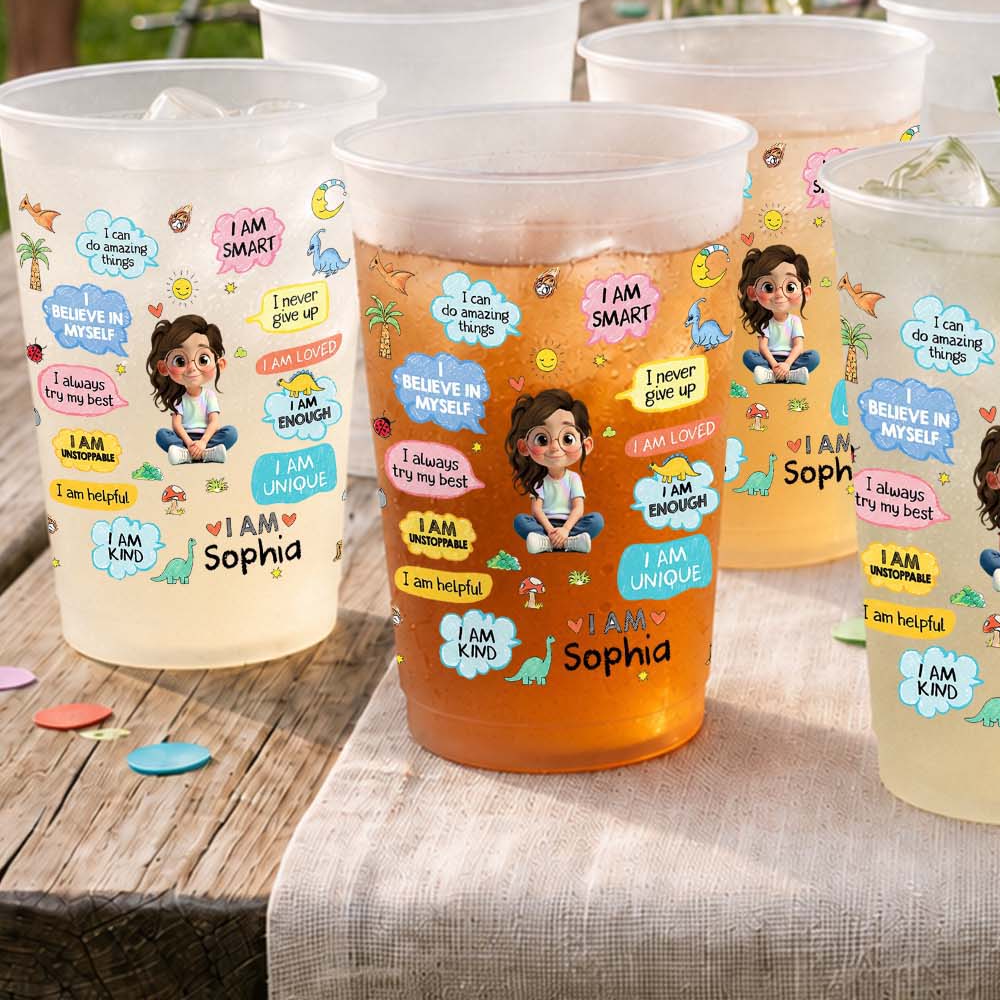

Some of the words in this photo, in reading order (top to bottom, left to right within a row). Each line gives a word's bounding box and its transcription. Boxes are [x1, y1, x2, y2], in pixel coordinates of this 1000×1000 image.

[103, 227, 110, 239] I
[111, 231, 131, 241] can
[231, 221, 236, 236] I
[240, 216, 267, 237] AM
[85, 239, 101, 251] do
[103, 243, 148, 257] amazing
[222, 235, 276, 258] SMART
[101, 254, 135, 270] things
[84, 292, 89, 306] I
[272, 294, 279, 310] I
[282, 290, 319, 308] never
[462, 291, 467, 303] I
[470, 295, 491, 305] can
[602, 287, 607, 304] I
[612, 283, 641, 304] AM
[51, 304, 106, 324] BELIEVE
[108, 311, 124, 326] IN
[272, 309, 299, 329] give
[302, 306, 319, 321] up
[441, 303, 458, 317] do
[460, 308, 510, 325] amazing
[592, 304, 652, 328] SMART
[934, 315, 940, 329] I
[942, 321, 964, 332] can
[64, 323, 115, 341] MYSELF
[458, 320, 495, 338] things
[911, 328, 929, 342] do
[931, 334, 983, 352] amazing
[263, 359, 266, 371] I
[271, 354, 293, 370] AM
[296, 340, 337, 363] LOVED
[928, 346, 967, 366] things
[438, 361, 443, 377] I
[53, 371, 59, 385] I
[62, 375, 106, 392] always
[402, 373, 461, 397] BELIEVE
[464, 384, 481, 399] IN
[44, 385, 64, 403] try
[66, 393, 84, 406] my
[87, 393, 114, 407] best
[290, 400, 294, 411] I
[297, 396, 318, 411] AM
[415, 395, 471, 416] MYSELF
[906, 388, 912, 404] I
[278, 406, 332, 429] ENOUGH
[868, 399, 930, 425] BELIEVE
[933, 412, 951, 428] IN
[70, 434, 76, 448] I
[78, 435, 105, 452] AM
[805, 435, 811, 453] I
[880, 421, 940, 446] MYSELF
[60, 448, 116, 463] UNSTOPPABLE
[275, 460, 280, 475] I
[286, 455, 314, 474] AM
[263, 471, 328, 496] UNIQUE
[783, 456, 853, 490] Soph
[56, 483, 63, 497] I
[66, 488, 84, 500] am
[86, 488, 130, 506] helpful
[866, 476, 872, 491] I
[875, 481, 925, 503] always
[854, 492, 876, 512] try
[880, 501, 900, 518] my
[903, 503, 934, 521] best
[226, 518, 232, 537] I
[239, 512, 278, 535] AM
[419, 517, 425, 533] I
[428, 519, 457, 537] AM
[108, 532, 113, 545] I
[118, 533, 142, 548] AM
[408, 533, 469, 550] UNSTOPPABLE
[108, 547, 144, 563] KIND
[204, 534, 302, 576] Sophia
[881, 549, 887, 565] I
[890, 551, 921, 571] AM
[402, 571, 410, 586] I
[413, 577, 433, 589] am
[436, 576, 484, 597] helpful
[869, 564, 932, 584] UNSTOPPABLE
[588, 615, 595, 634] I
[603, 609, 646, 633] AM
[863, 604, 869, 620] I
[872, 610, 894, 624] am
[897, 611, 946, 633] helpful
[563, 633, 671, 677] Sophia
[918, 663, 924, 678] I
[929, 665, 957, 682] AM
[917, 680, 958, 700] KIND
